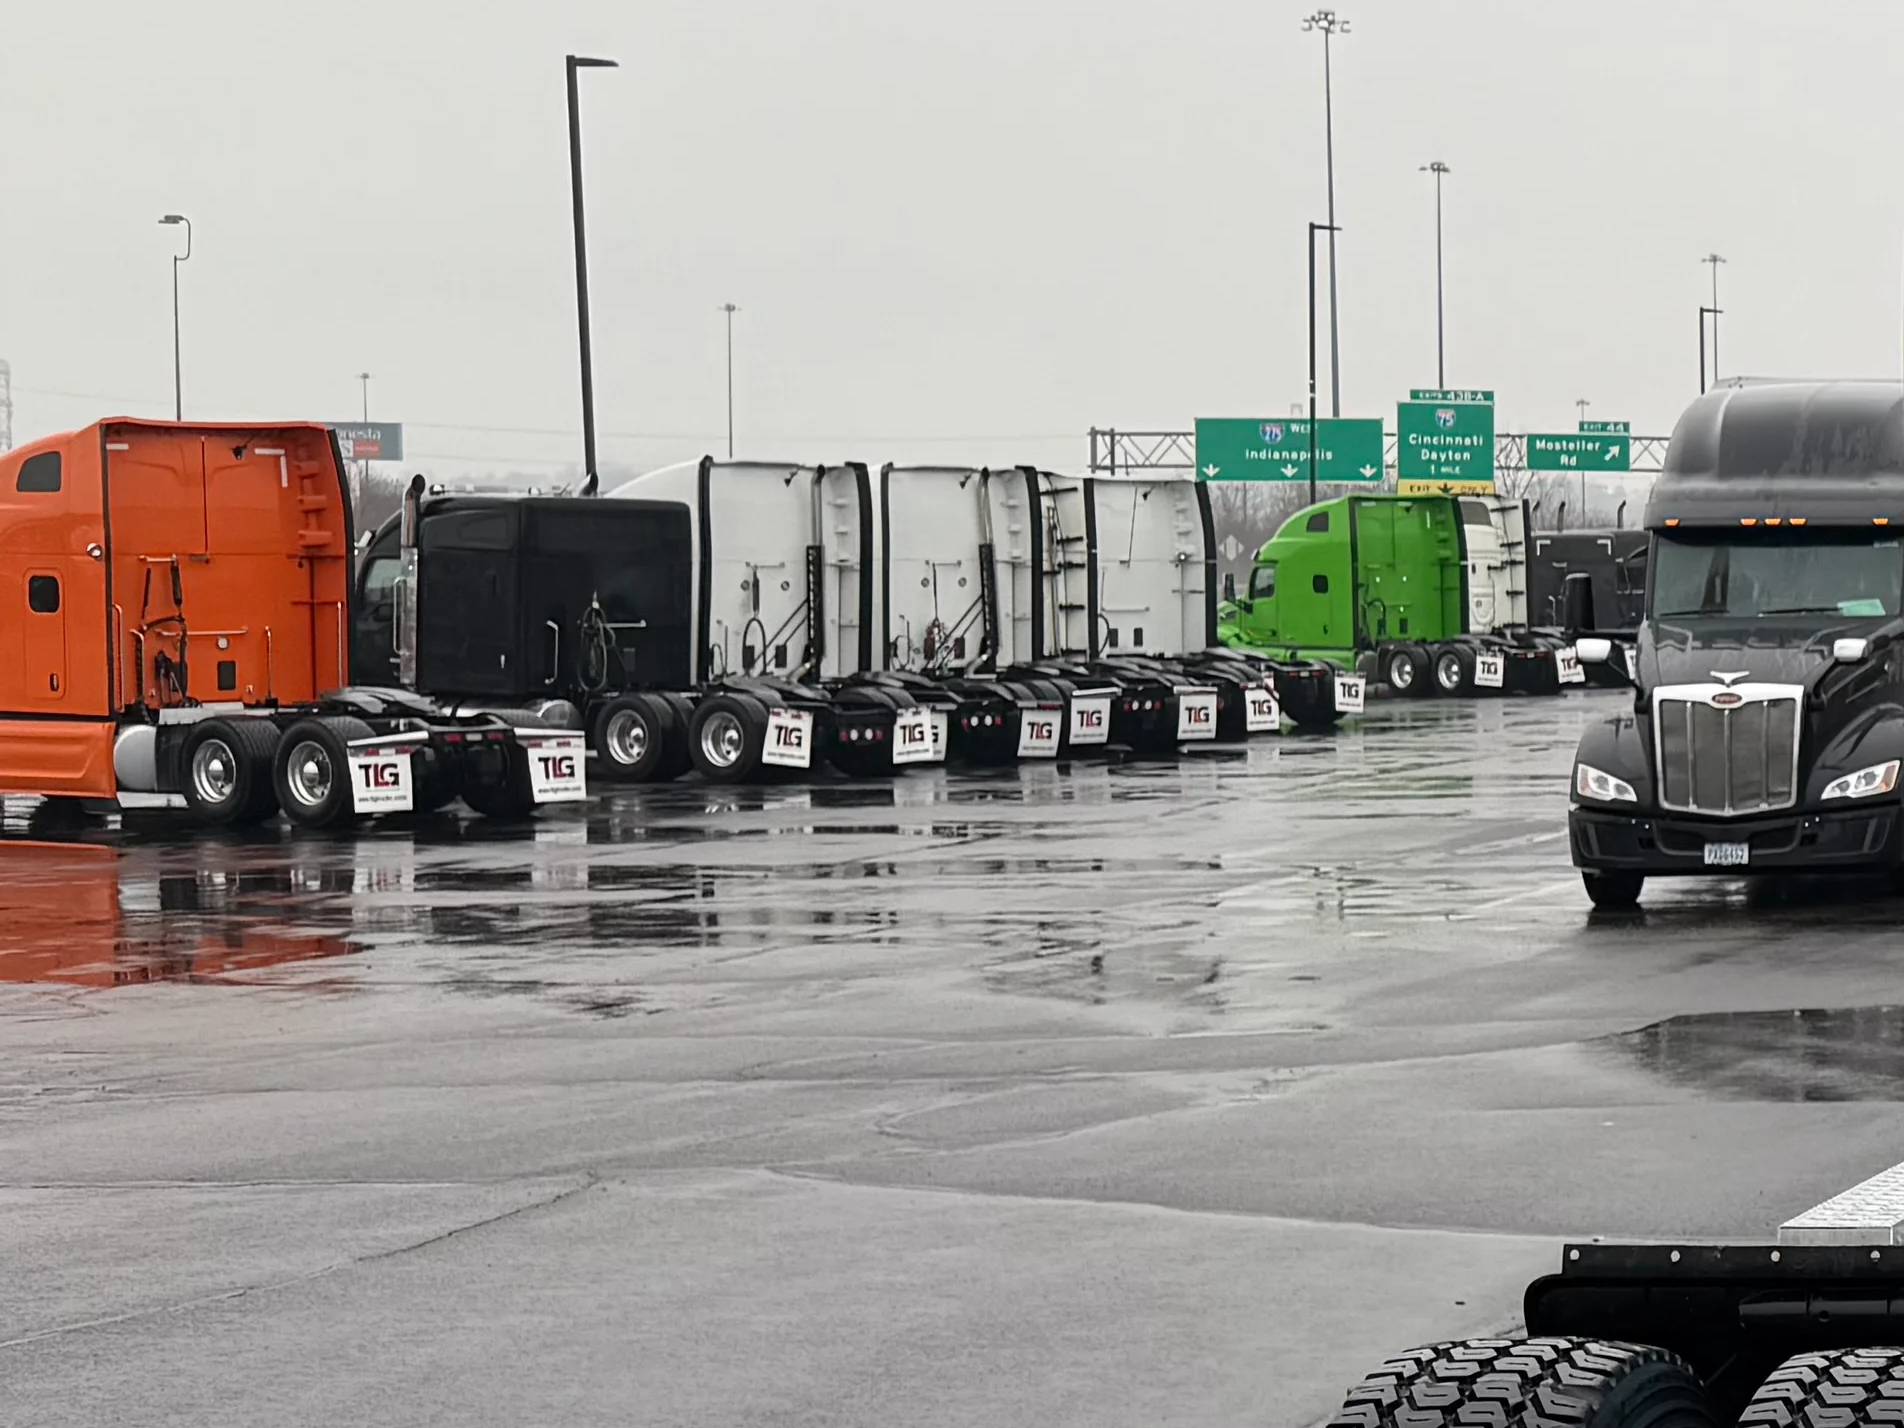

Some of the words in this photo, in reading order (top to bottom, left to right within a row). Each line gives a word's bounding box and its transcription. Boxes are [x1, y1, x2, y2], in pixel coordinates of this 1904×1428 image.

[1437, 410, 1454, 425] 75
[1606, 423, 1624, 431] 44
[1409, 433, 1484, 446] Cincinnati
[1535, 439, 1600, 451] Mosteller
[1421, 449, 1471, 463] Dayton
[1560, 454, 1577, 466] Rd
[1430, 465, 1435, 475] 1
[1409, 484, 1431, 493] EXIT
[1076, 709, 1102, 727] TLG
[1185, 705, 1209, 724] TLG
[775, 725, 802, 747] TLG
[899, 723, 924, 745] TLG
[1027, 721, 1053, 740] TLG
[358, 763, 399, 788] TLG
[538, 756, 575, 780] TLG
